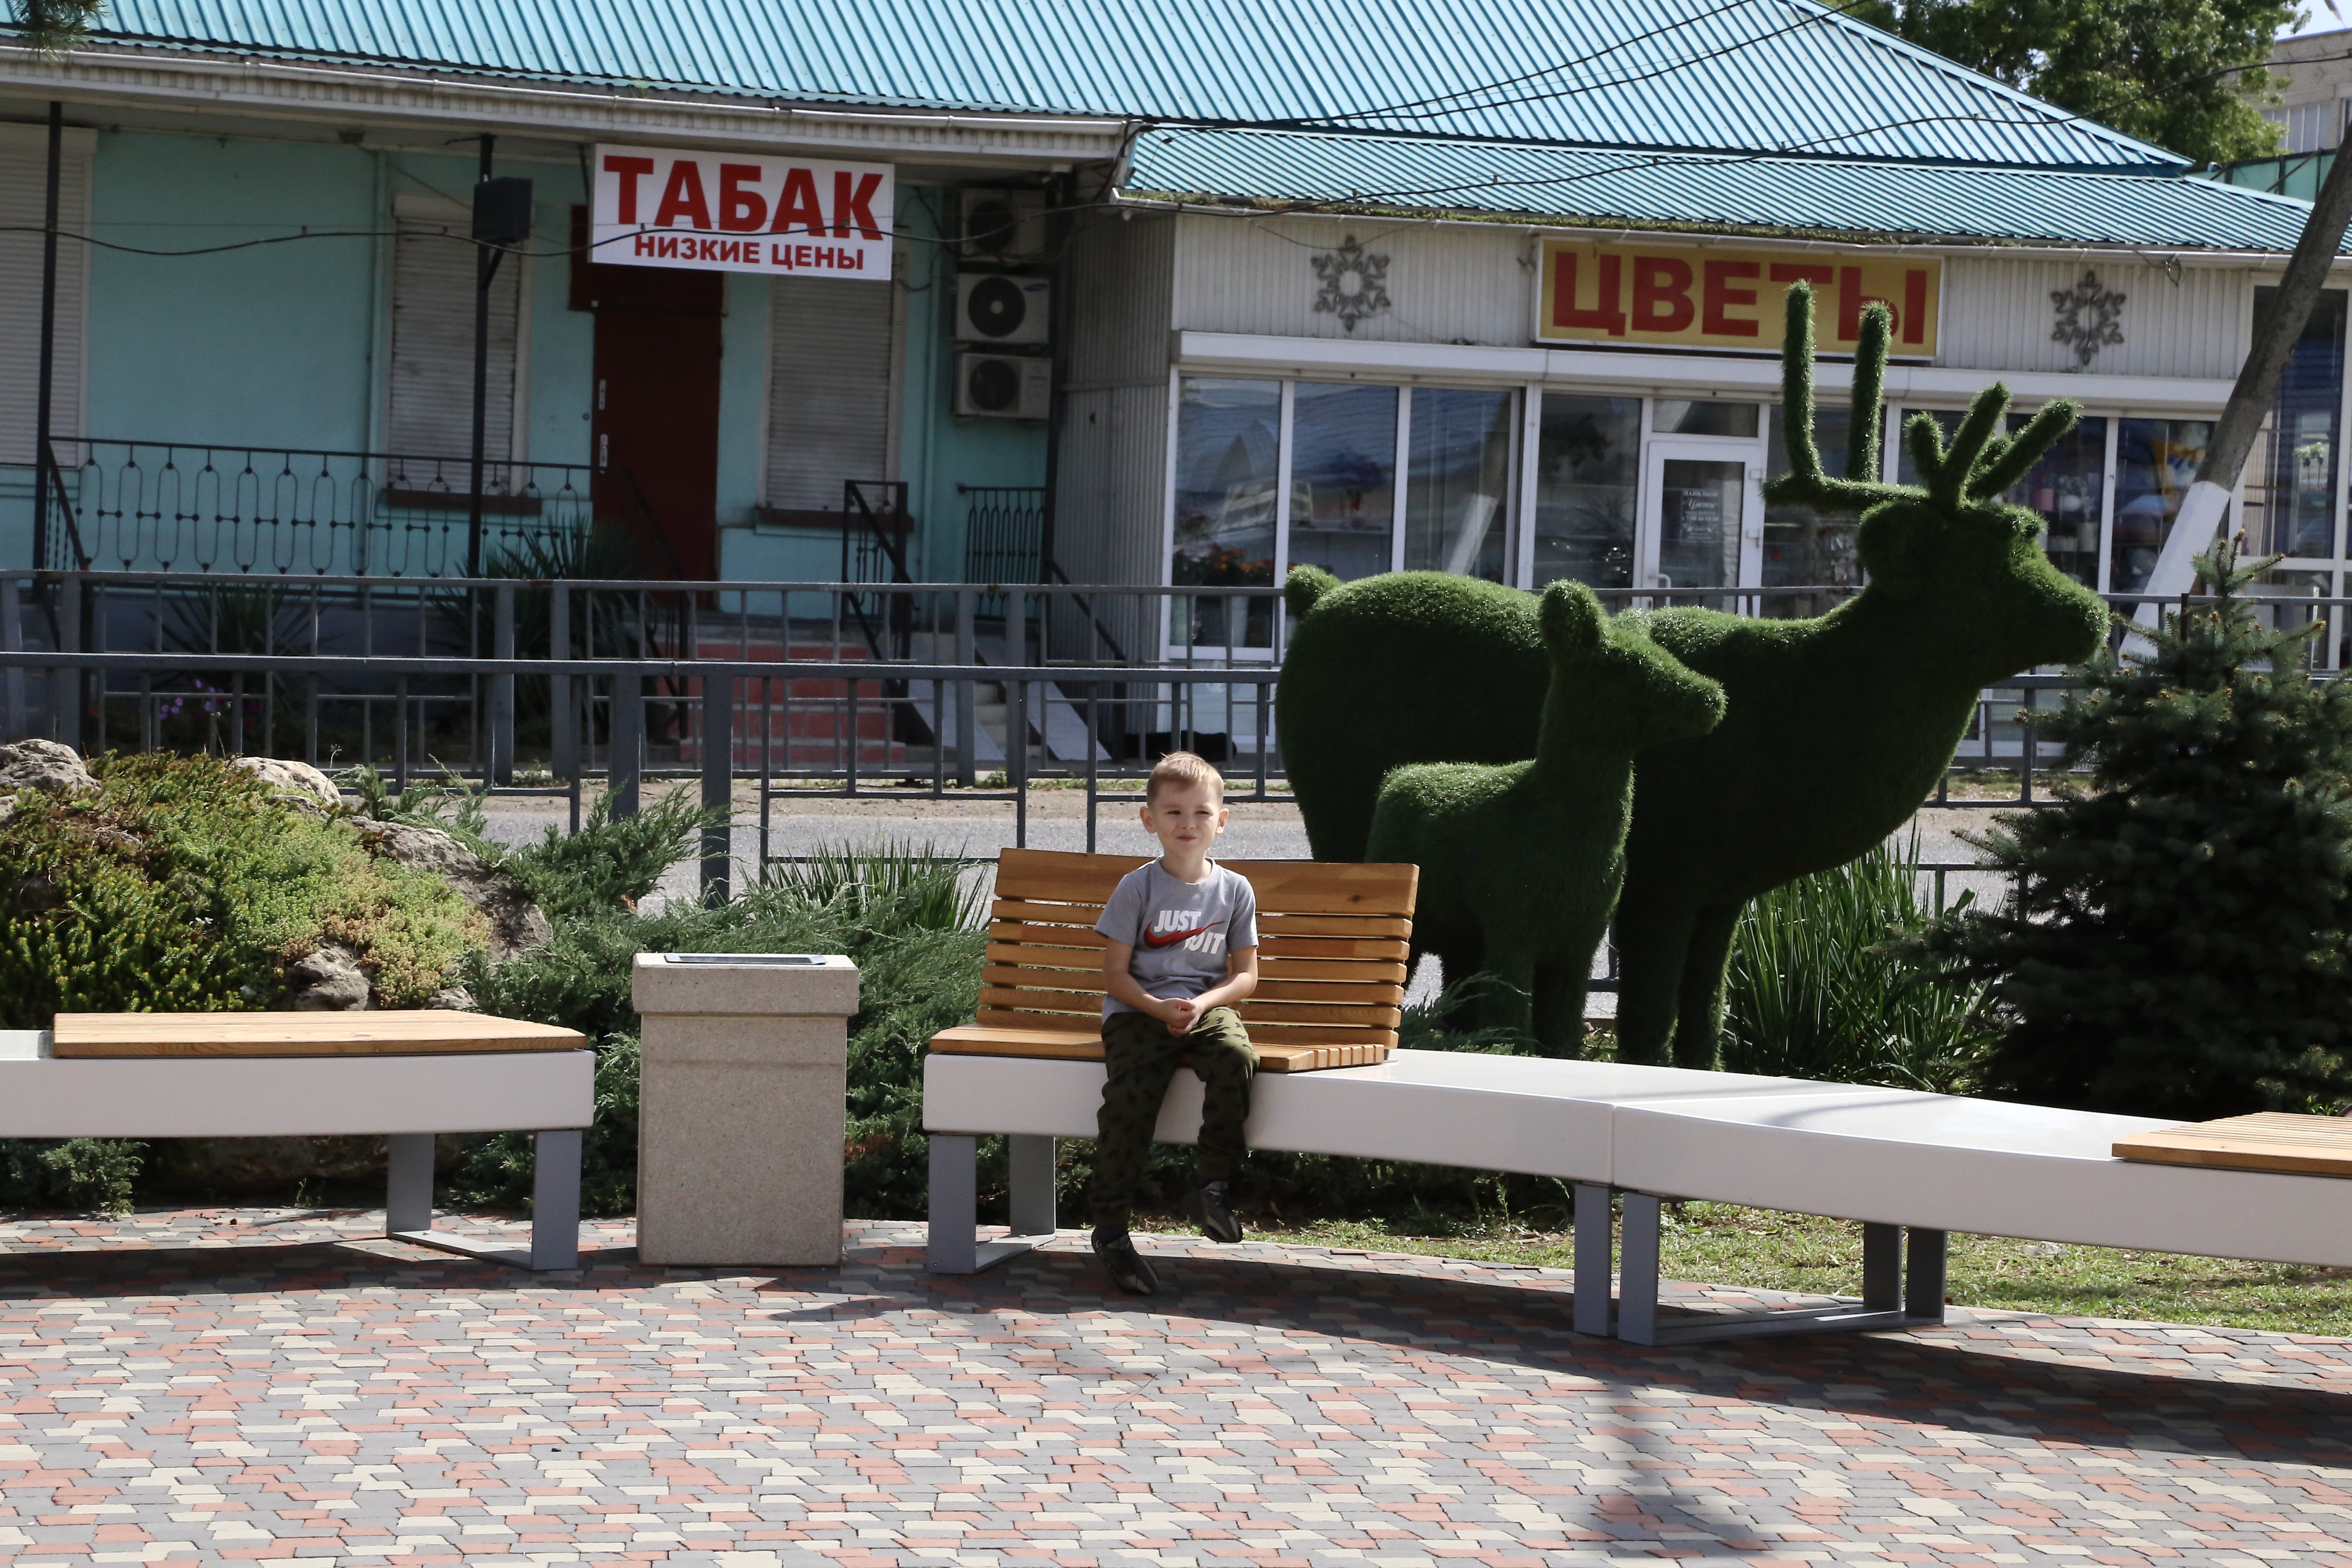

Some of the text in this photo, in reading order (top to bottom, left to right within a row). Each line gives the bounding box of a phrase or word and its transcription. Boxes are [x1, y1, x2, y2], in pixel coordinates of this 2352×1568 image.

[604, 155, 884, 241] ТАБАК
[635, 233, 864, 270] НИЗКИЕ ЦЕНЫ
[1553, 251, 1927, 344] ЦВЕТЫ
[1154, 910, 1202, 932] JUST
[1201, 932, 1225, 955] IT
